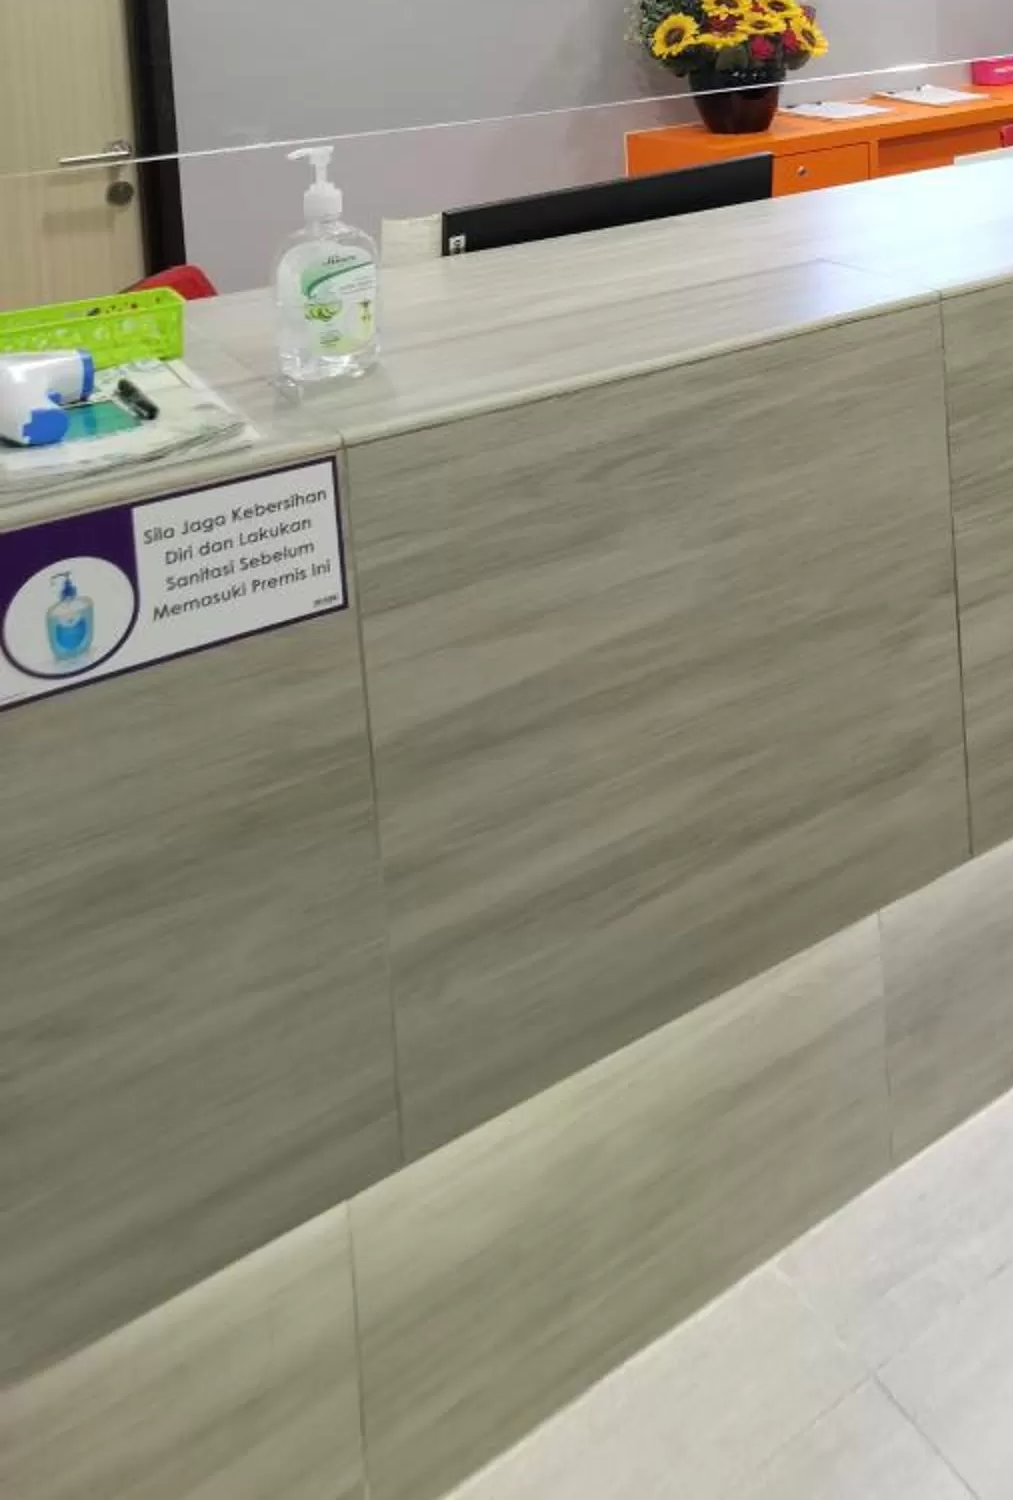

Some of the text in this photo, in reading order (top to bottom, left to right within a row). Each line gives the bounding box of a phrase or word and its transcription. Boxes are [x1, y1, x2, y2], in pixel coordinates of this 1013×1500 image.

[143, 488, 327, 545] Sila Jaga Kebersihan
[165, 518, 312, 566] Diri dan Lakukan
[153, 558, 332, 621] Memasuki Premis Ini
[166, 541, 315, 591] Sanitasi Sebelum
